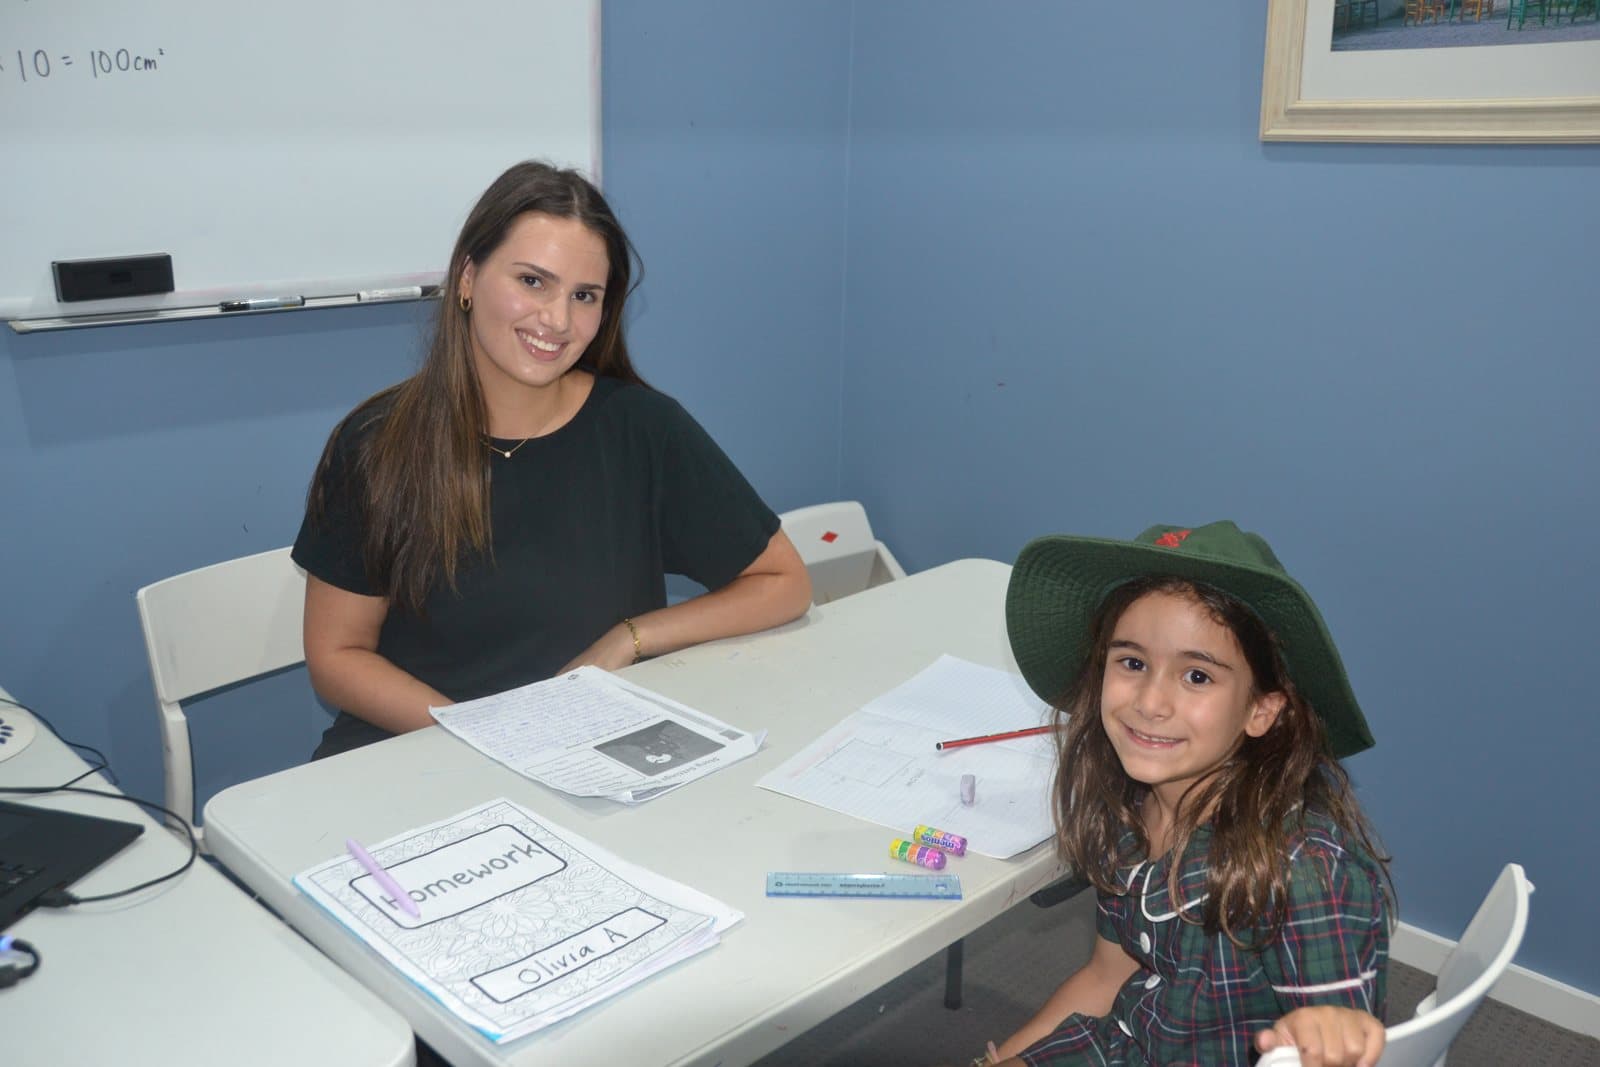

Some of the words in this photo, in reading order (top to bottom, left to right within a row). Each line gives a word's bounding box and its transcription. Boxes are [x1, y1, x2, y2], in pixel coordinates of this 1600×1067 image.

[18, 49, 51, 82] 10
[920, 834, 955, 849] mentos
[518, 945, 595, 984] Olivia
[603, 927, 628, 943] A
